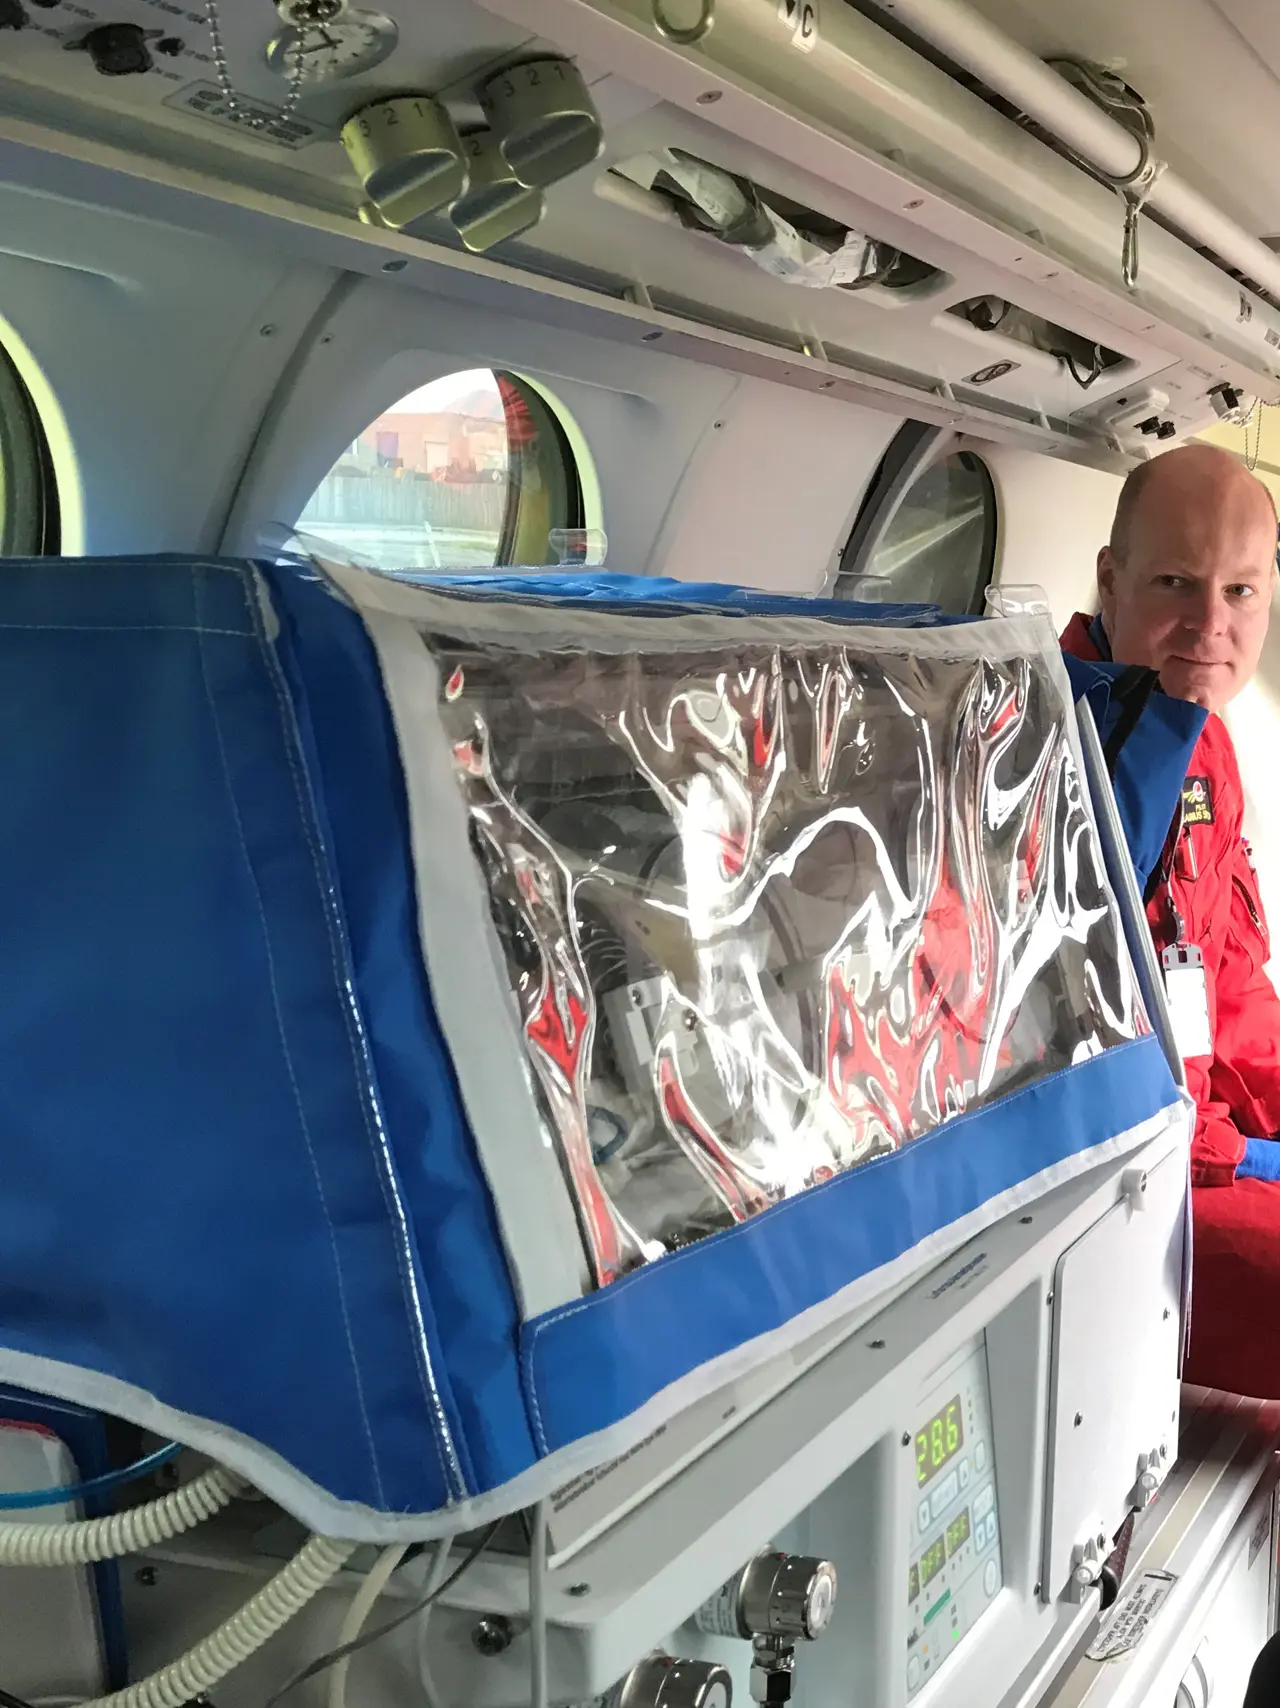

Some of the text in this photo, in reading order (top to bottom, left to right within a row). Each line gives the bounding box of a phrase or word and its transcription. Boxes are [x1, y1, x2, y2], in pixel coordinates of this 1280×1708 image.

[503, 64, 566, 97] 3 2 1
[359, 102, 424, 138] 3 2 1
[469, 140, 483, 157] 2
